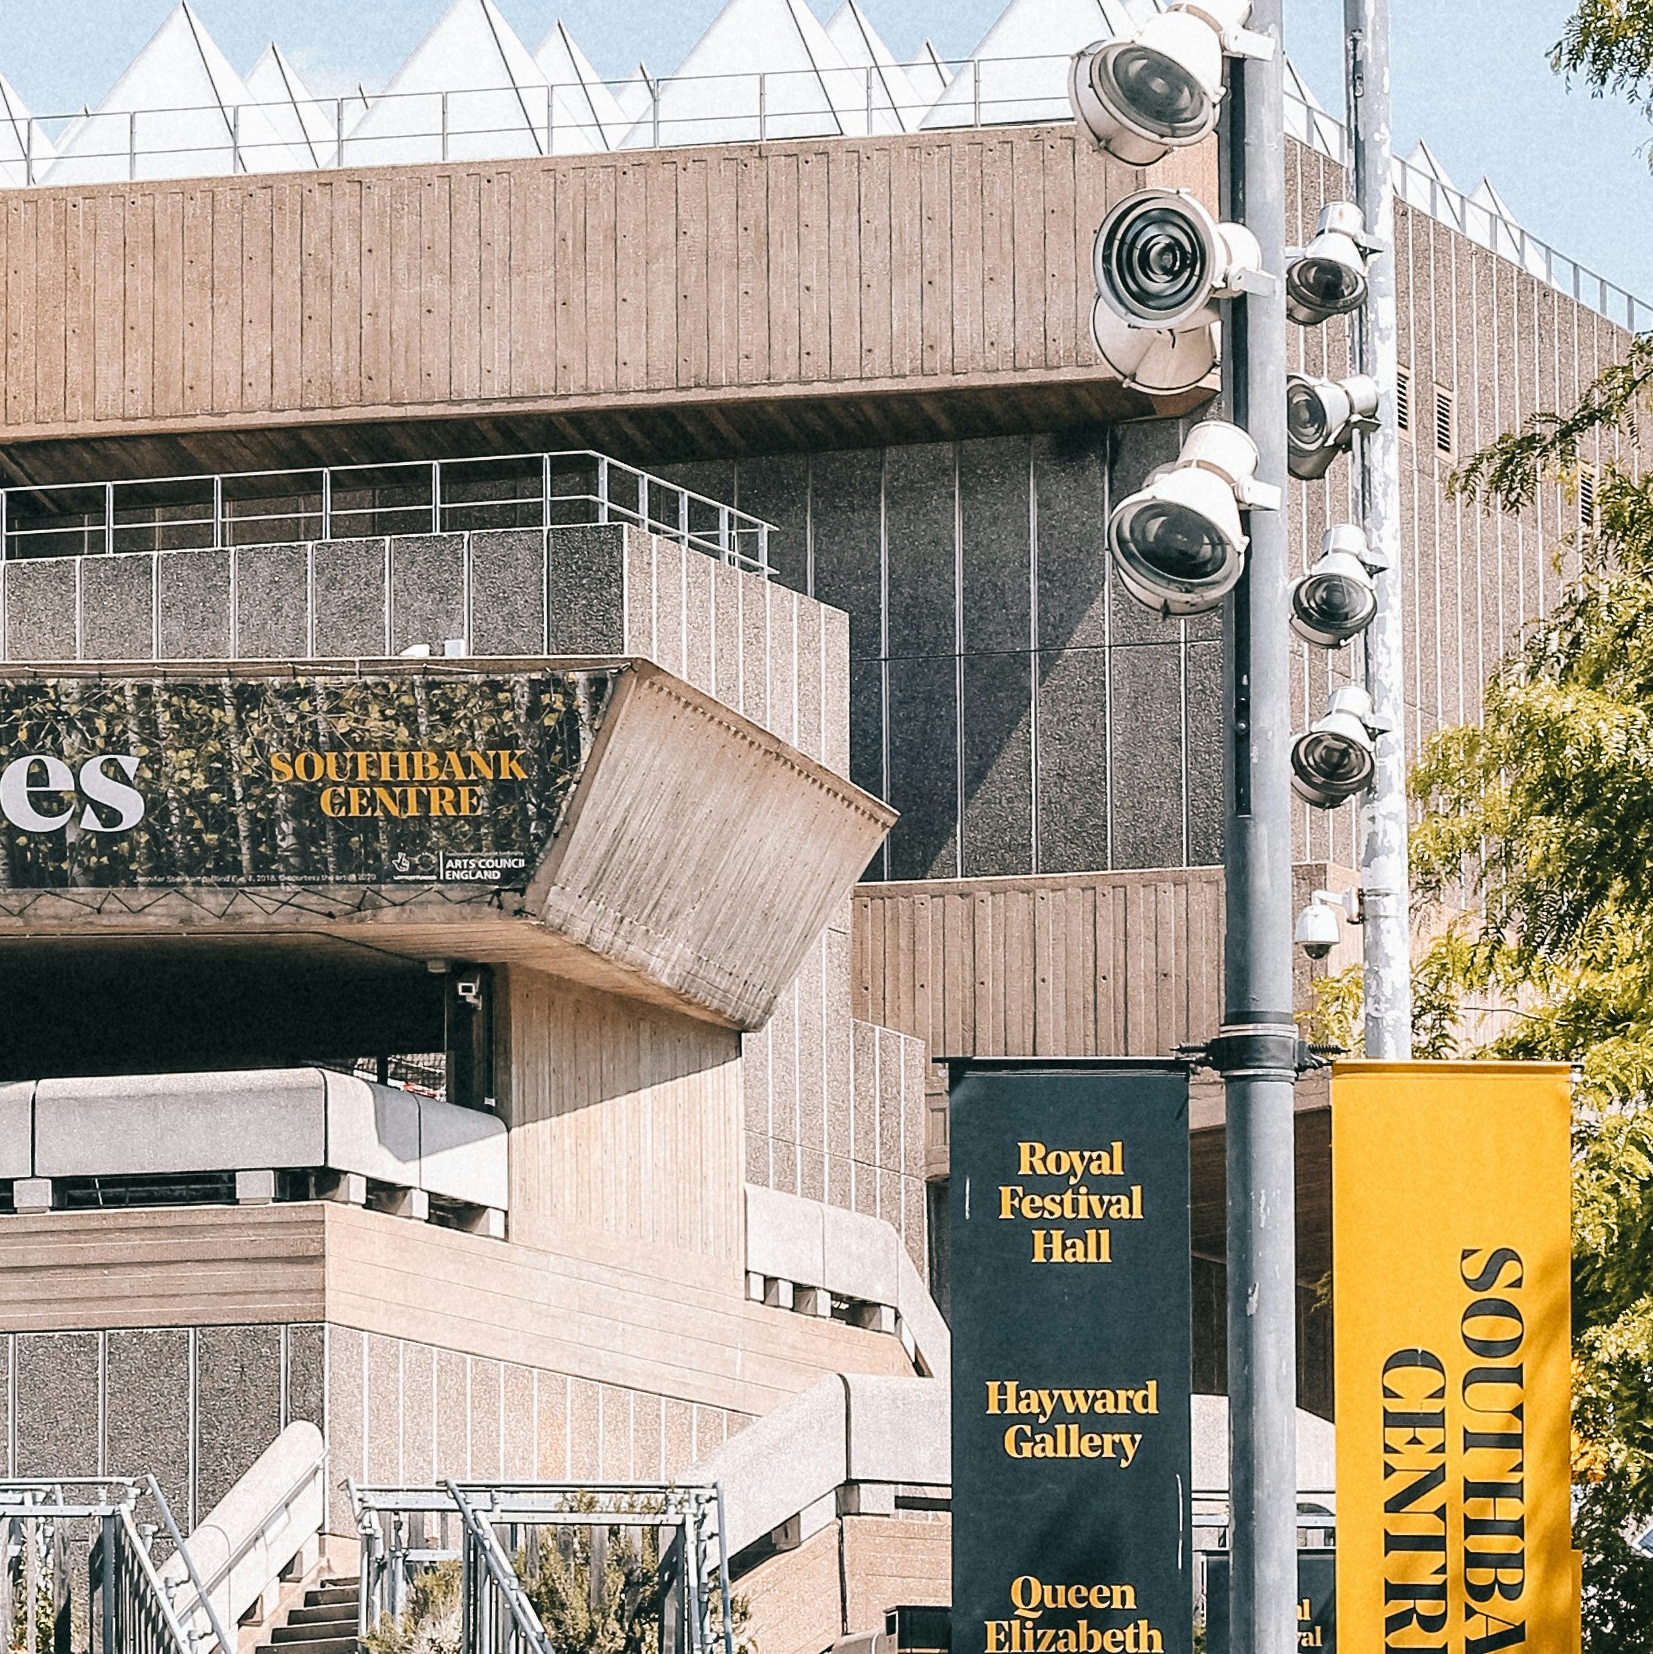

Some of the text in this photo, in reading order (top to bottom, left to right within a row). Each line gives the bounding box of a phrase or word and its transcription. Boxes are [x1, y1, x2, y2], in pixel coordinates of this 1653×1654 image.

[269, 748, 528, 783] SOUTHBANK
[319, 784, 484, 819] CENTRE
[445, 859, 475, 869] ARTS
[445, 870, 501, 880] ENGLAND
[1017, 1141, 1124, 1181] Royal
[998, 1184, 1143, 1220] Festival
[1032, 1229, 1111, 1264] Hall
[986, 1379, 1159, 1424] Hayward
[1003, 1424, 1143, 1469] Gallery
[1009, 1577, 1136, 1619] Queen
[985, 1619, 1164, 1654] Elizabeth
